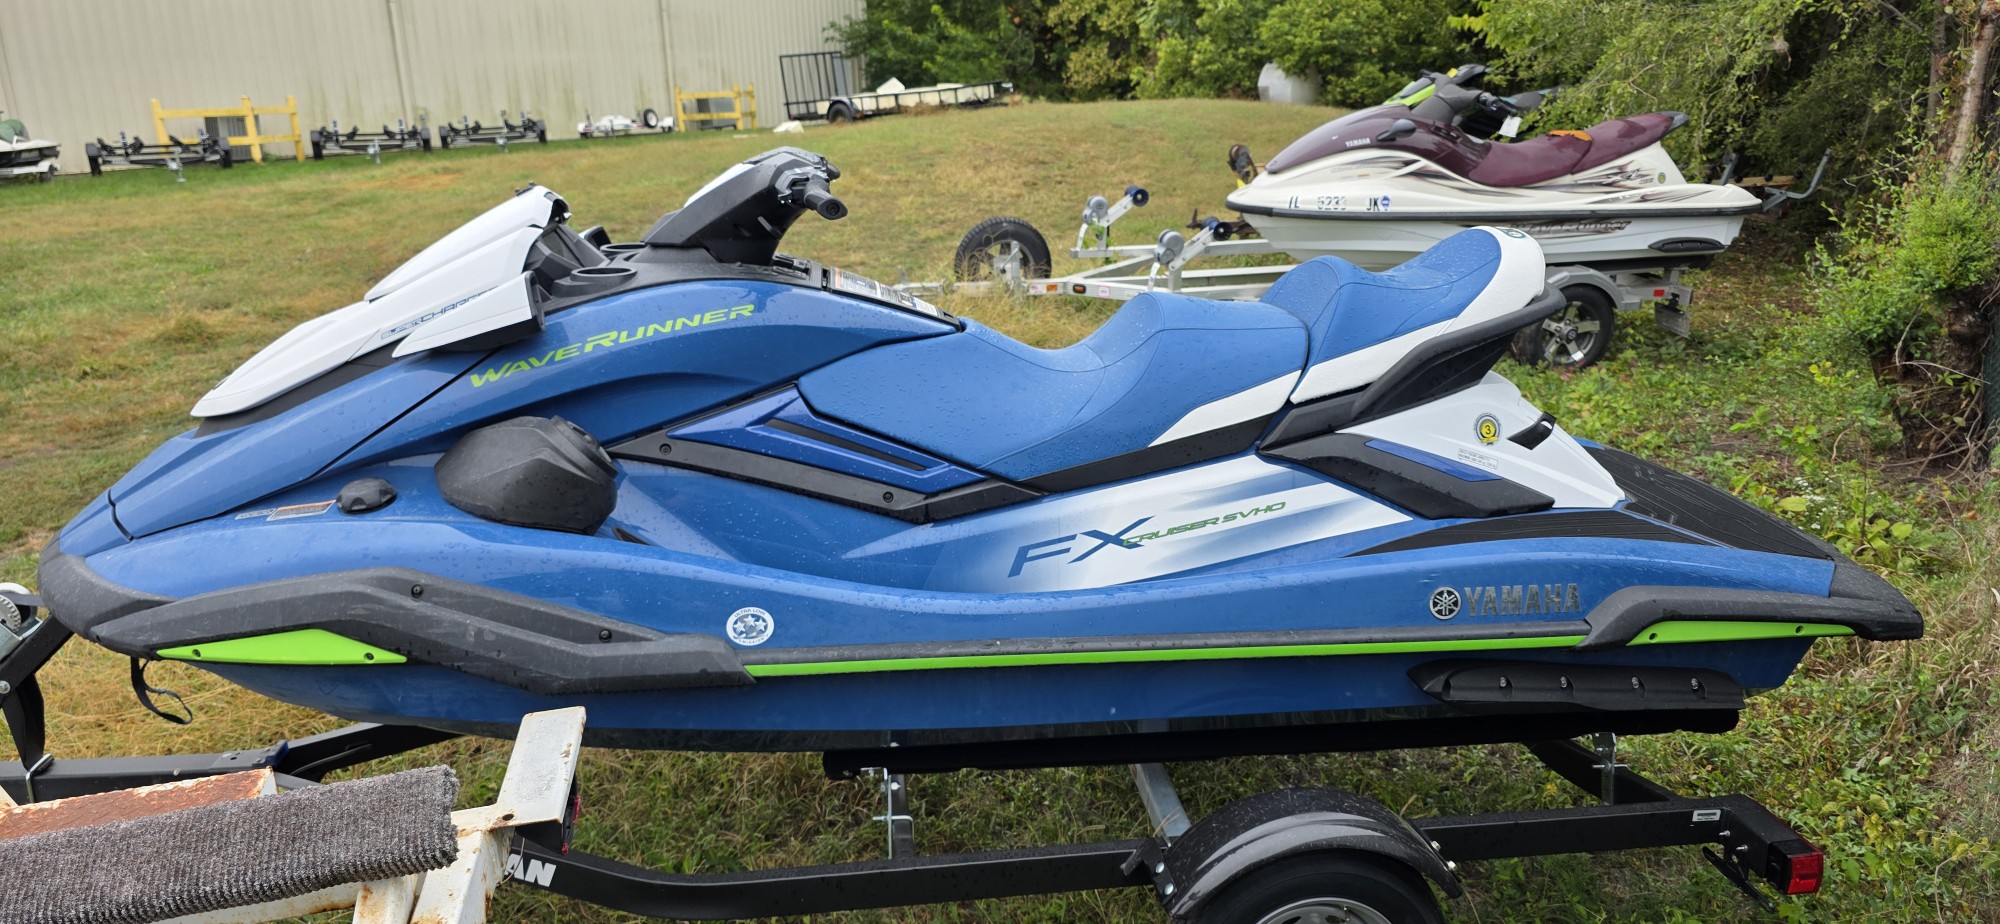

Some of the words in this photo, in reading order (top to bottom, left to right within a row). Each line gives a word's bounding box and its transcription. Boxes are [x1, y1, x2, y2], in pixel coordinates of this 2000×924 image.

[1345, 137, 1371, 148] YAMAHA
[1288, 196, 1300, 209] IL
[1366, 197, 1380, 211] JK
[1484, 424, 1492, 435] 3
[1007, 515, 1156, 578] FX
[1122, 516, 1220, 547] CRUISER
[1221, 501, 1287, 524] SVHO
[1463, 583, 1581, 617] YAMAHA
[734, 608, 751, 618] ULTRA
[752, 608, 766, 616] LOW
